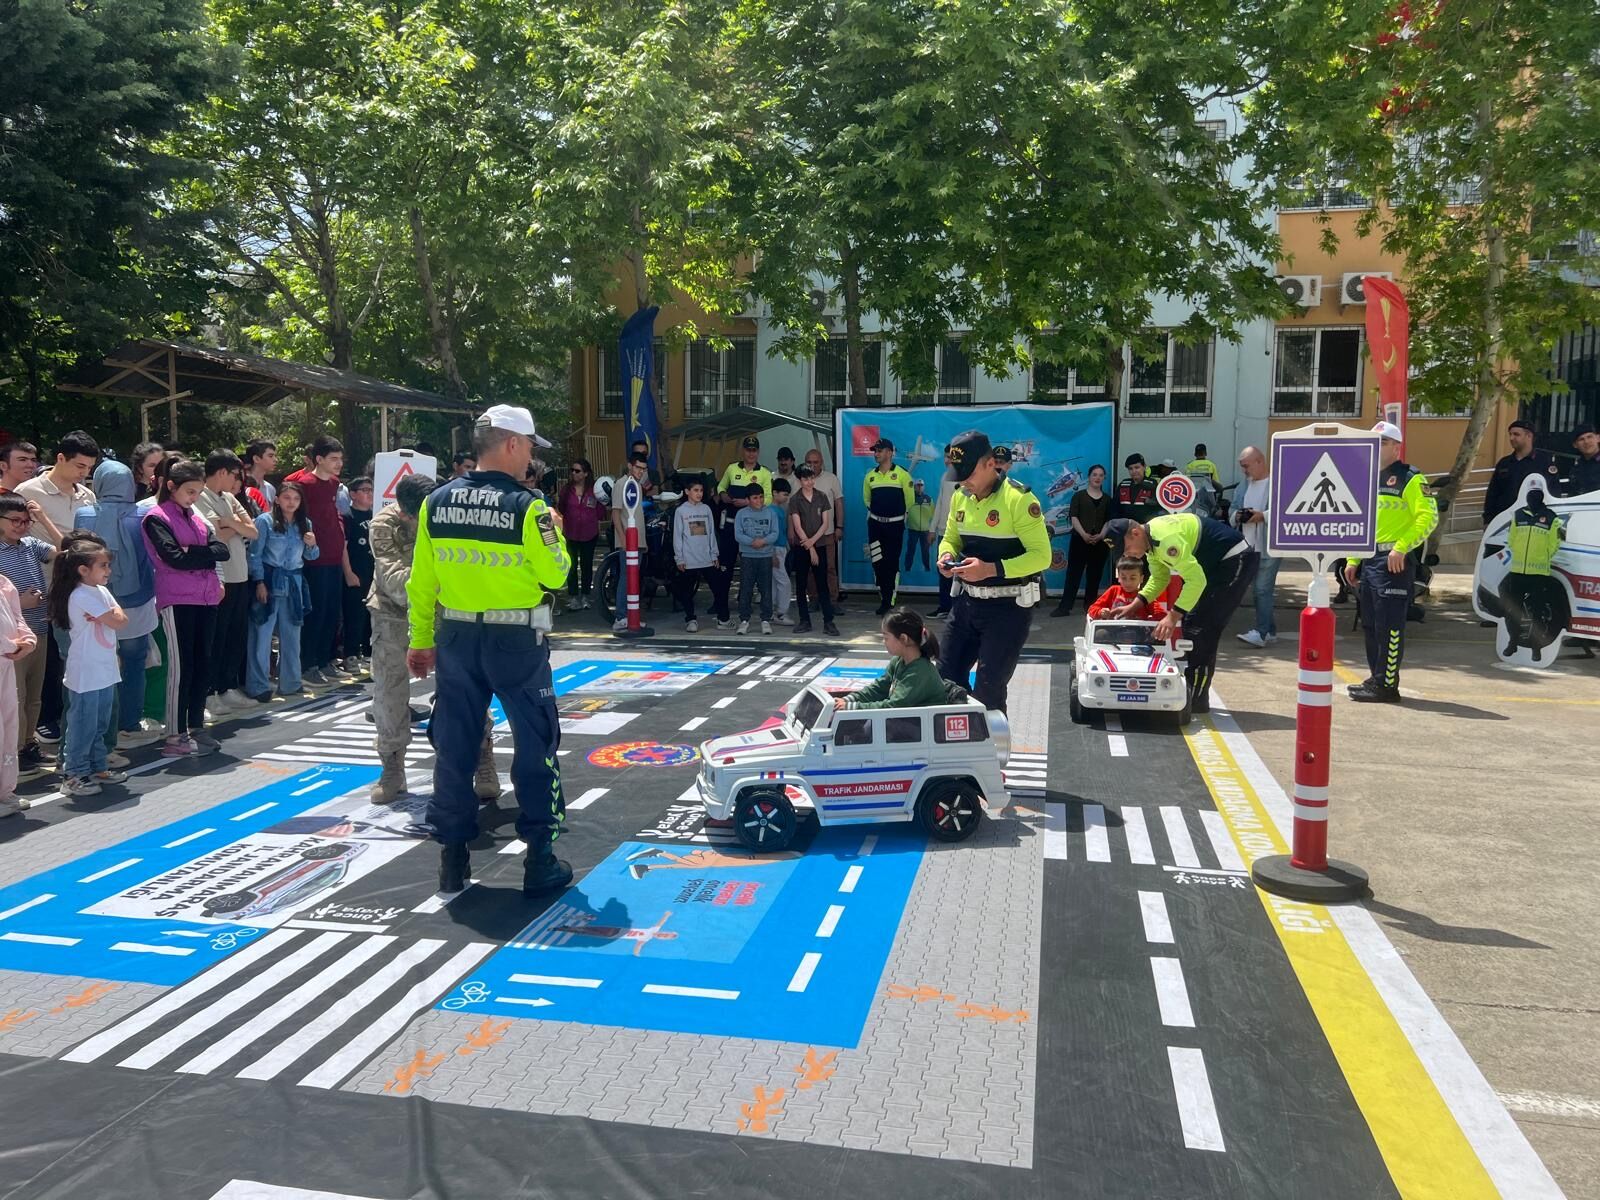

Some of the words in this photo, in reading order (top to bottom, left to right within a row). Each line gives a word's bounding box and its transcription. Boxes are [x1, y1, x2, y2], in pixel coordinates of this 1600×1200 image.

[432, 506, 515, 530] JANDARMASI
[1283, 522, 1317, 536] YAYA
[949, 719, 965, 730] 112
[853, 783, 904, 794] JANDARMASI
[120, 843, 253, 899] KOMUTANLIĞI
[150, 853, 259, 901] JANDARMA
[154, 836, 326, 917] KAHRAMANMARAŞ
